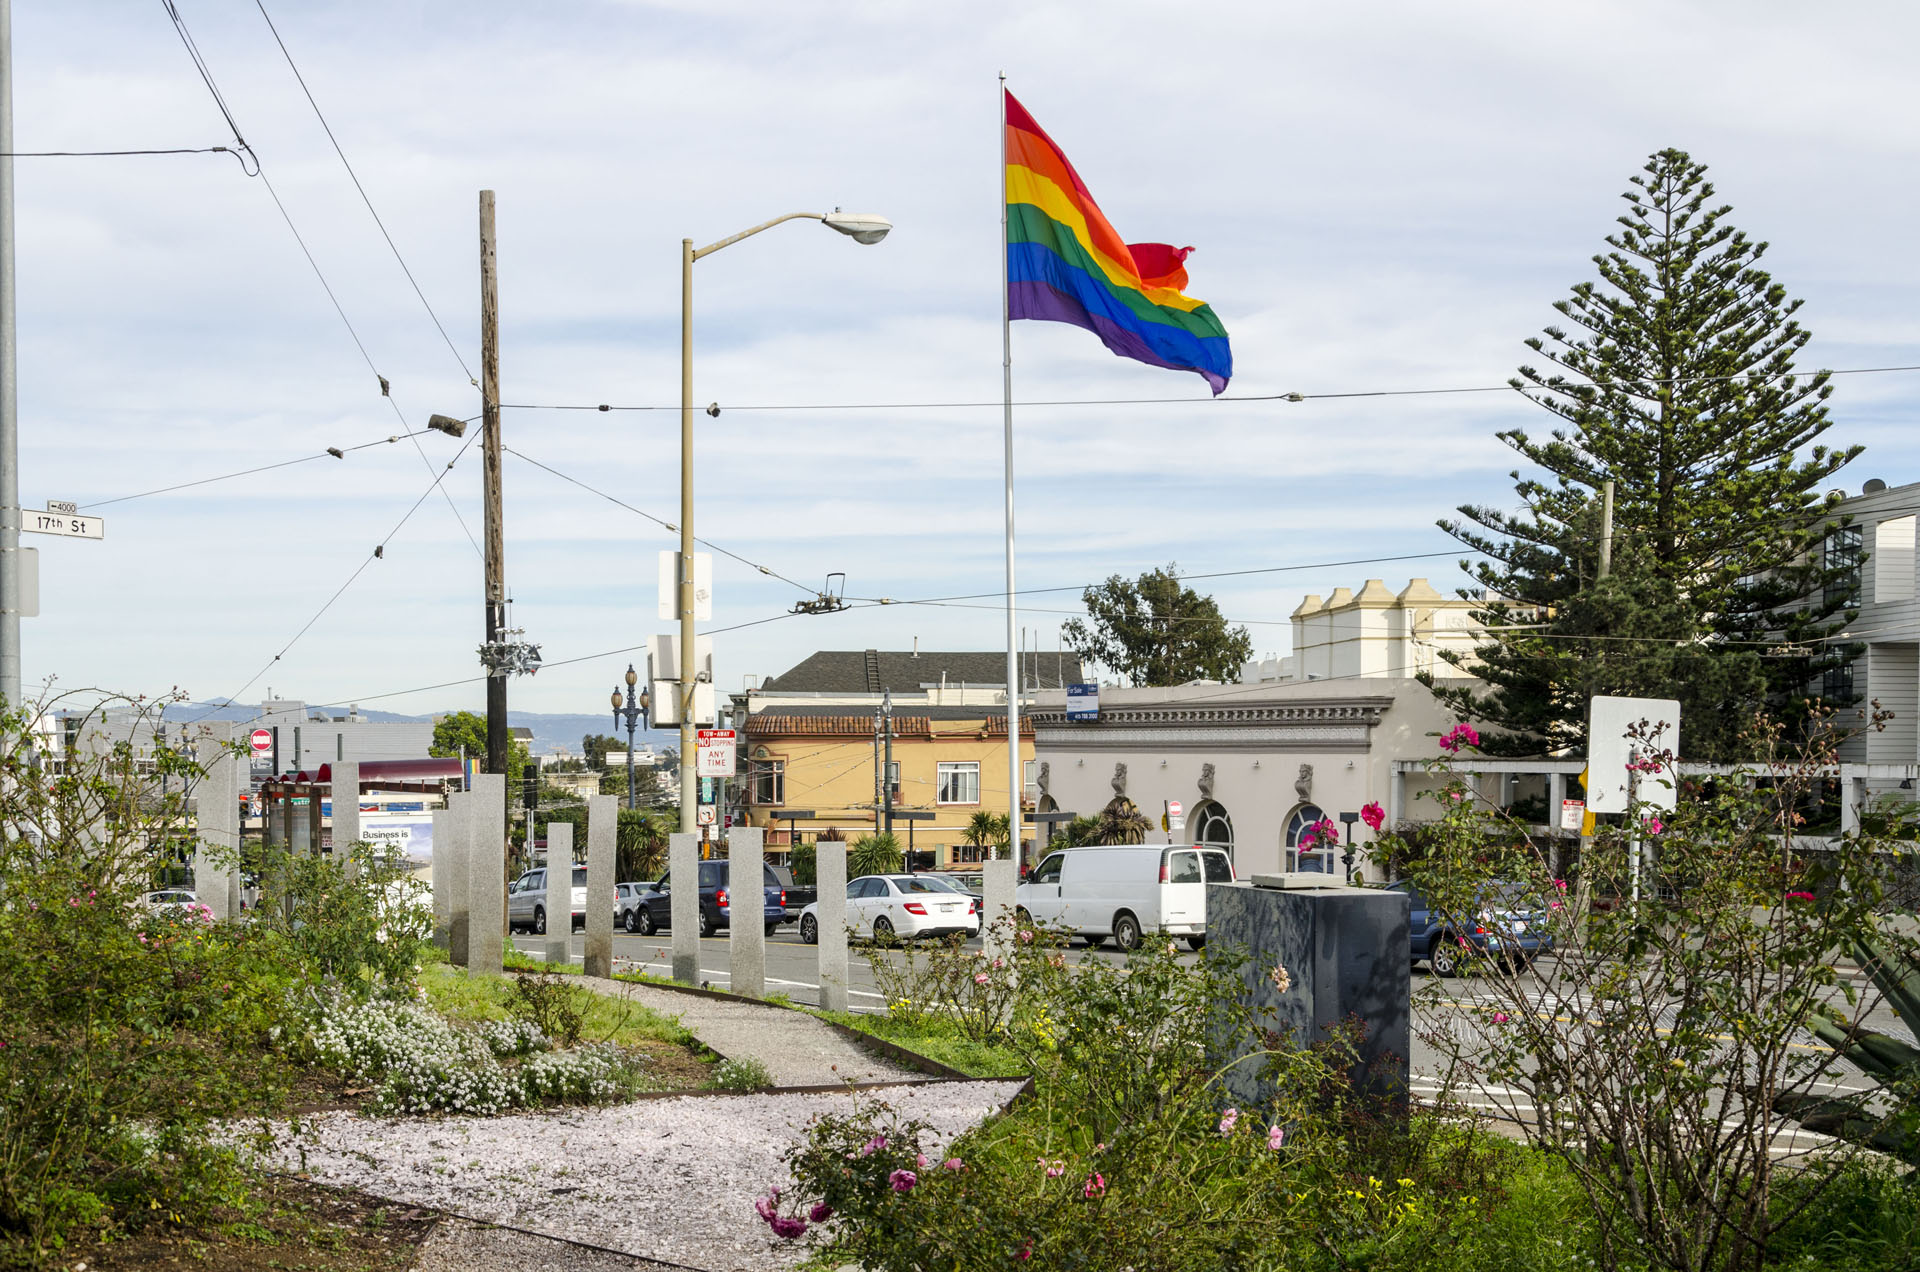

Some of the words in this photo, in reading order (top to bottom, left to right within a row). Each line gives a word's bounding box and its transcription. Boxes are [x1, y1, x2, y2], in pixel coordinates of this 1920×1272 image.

[57, 503, 76, 513] 4000
[37, 516, 63, 529] 17th
[71, 519, 86, 533] St
[699, 737, 710, 747] NO
[709, 750, 725, 758] ANY
[707, 759, 726, 767] TIME
[362, 830, 400, 839] Business
[401, 830, 409, 838] is
